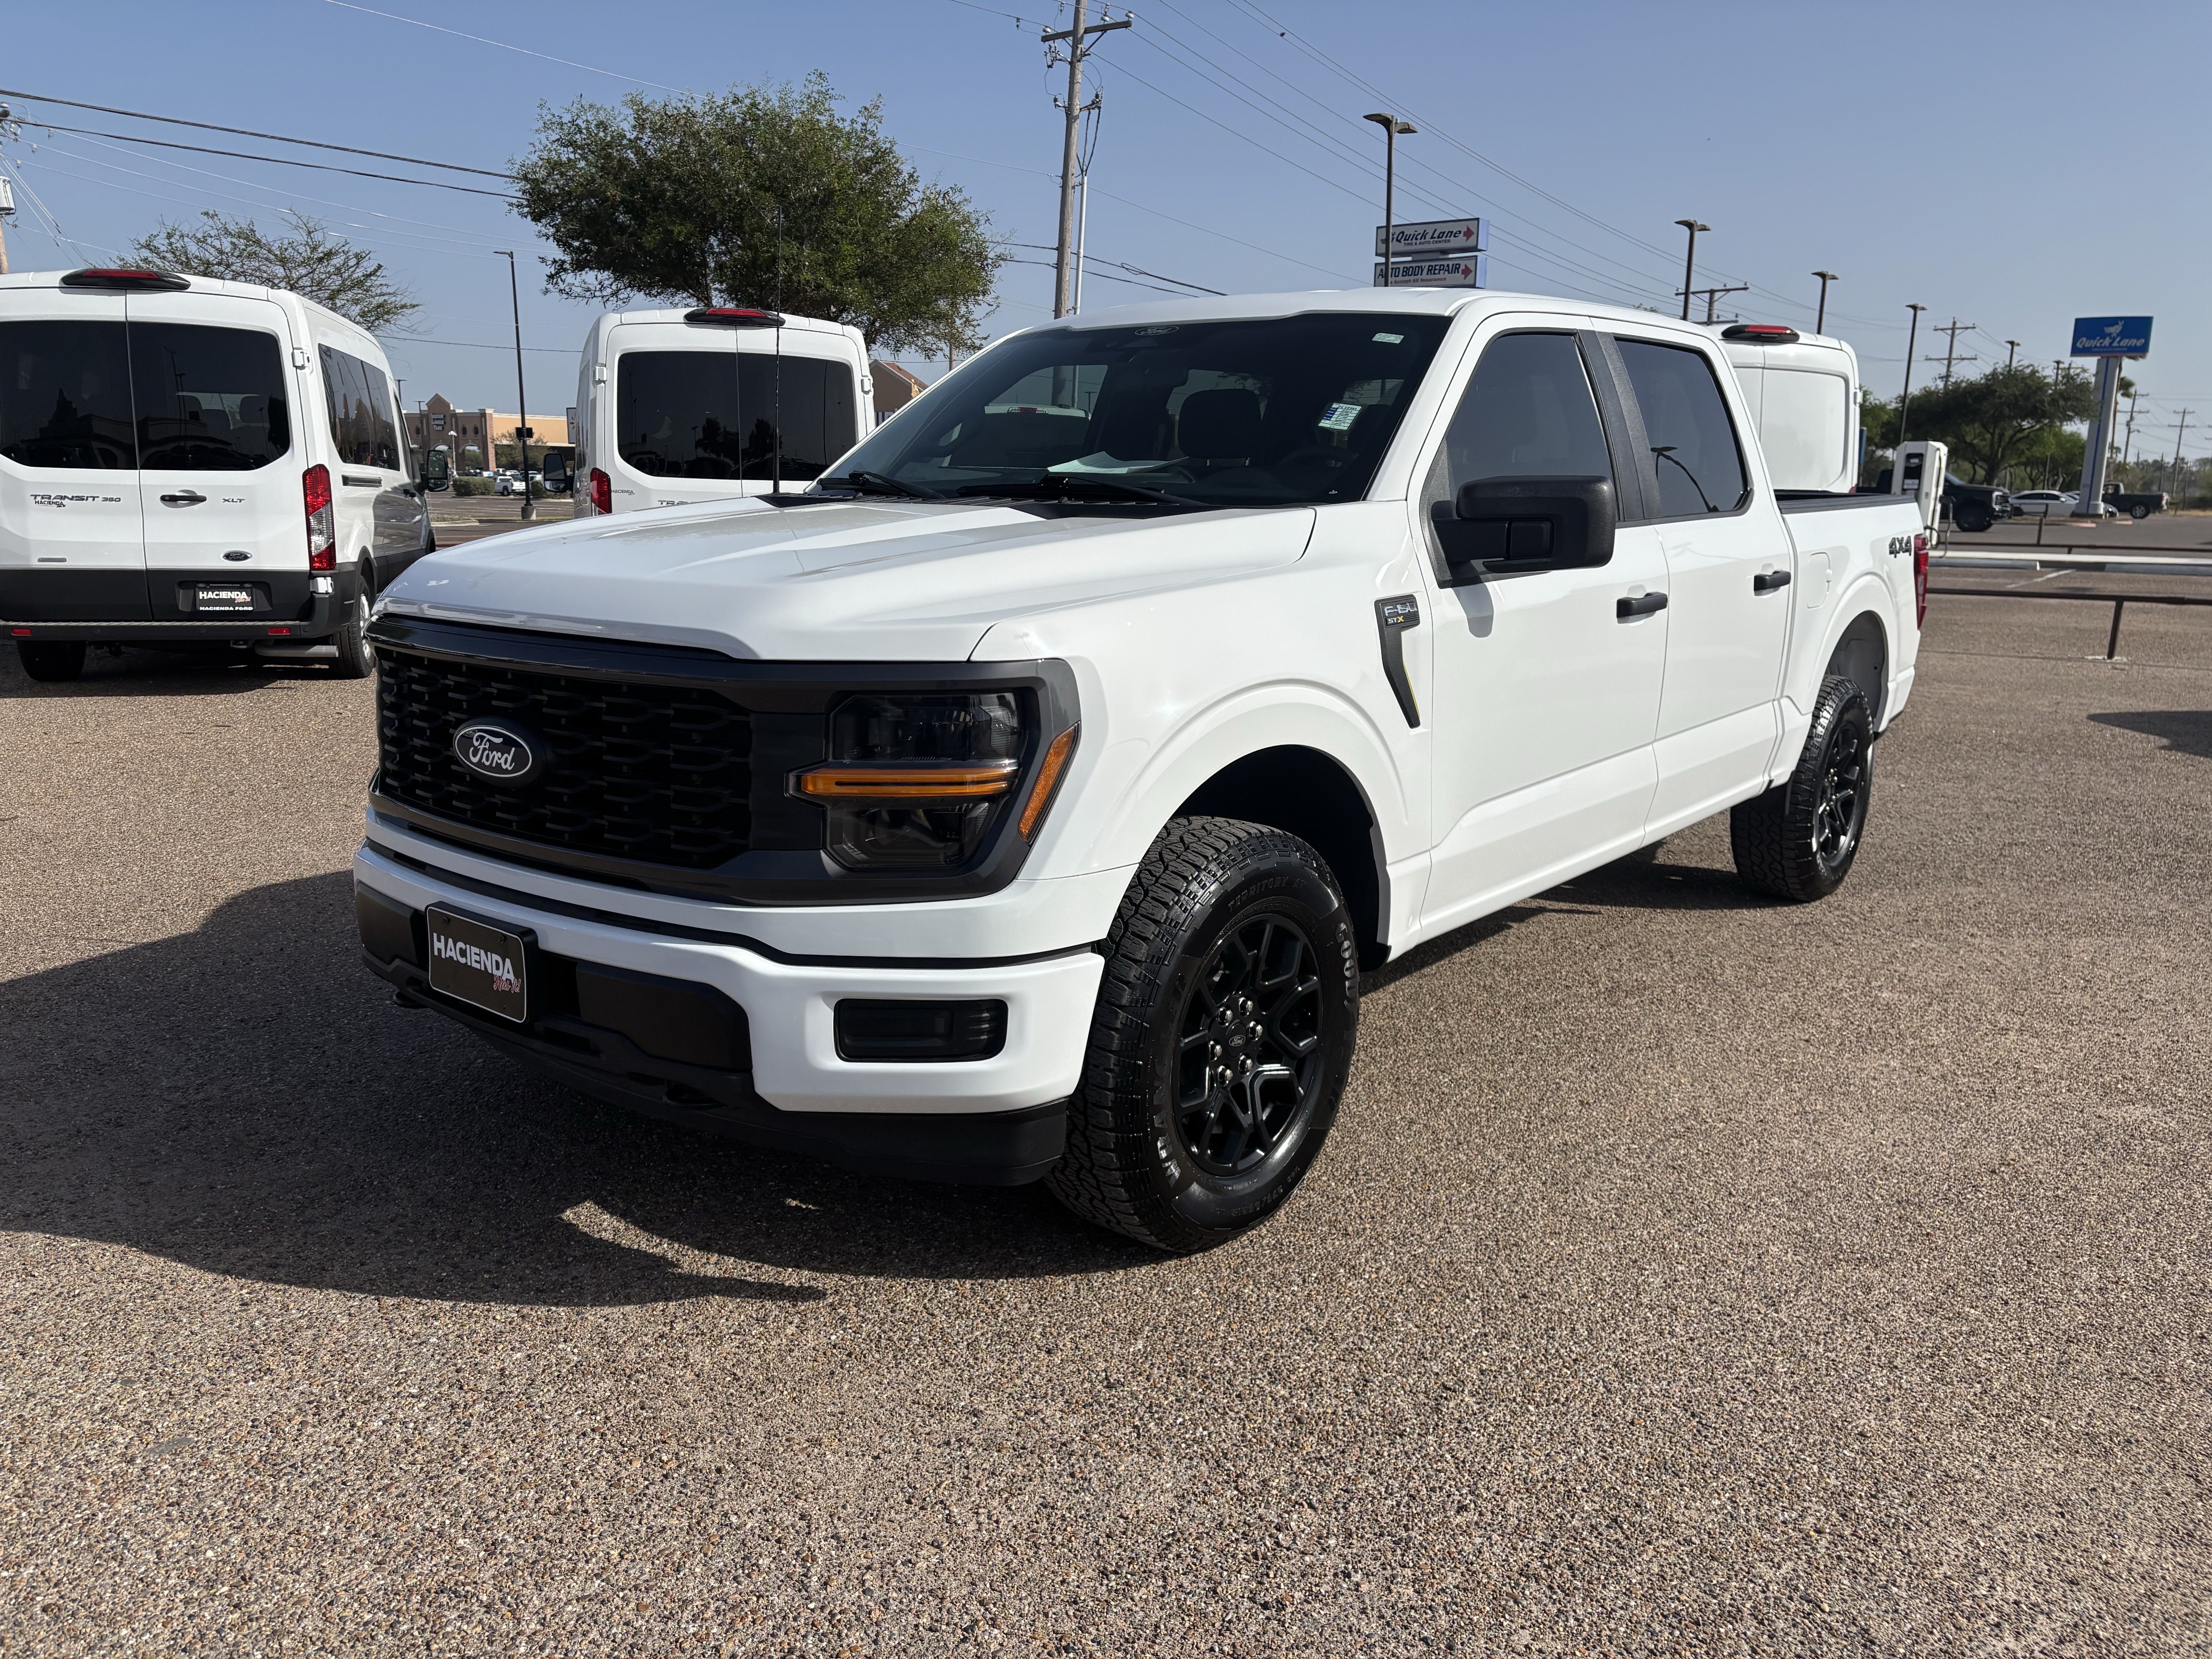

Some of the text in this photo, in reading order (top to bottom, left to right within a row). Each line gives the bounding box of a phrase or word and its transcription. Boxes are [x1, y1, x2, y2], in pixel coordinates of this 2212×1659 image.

[1396, 228, 1462, 243] Quick Lane
[1377, 263, 1461, 279] ATO BODY REPAIR
[2076, 336, 2145, 348] Quick Lane
[1384, 603, 1417, 616] F-150
[469, 732, 515, 770] Ford
[1228, 877, 1289, 912] TERRITORY
[433, 933, 514, 983] HACIENDA
[1232, 1037, 1243, 1045] Ford
